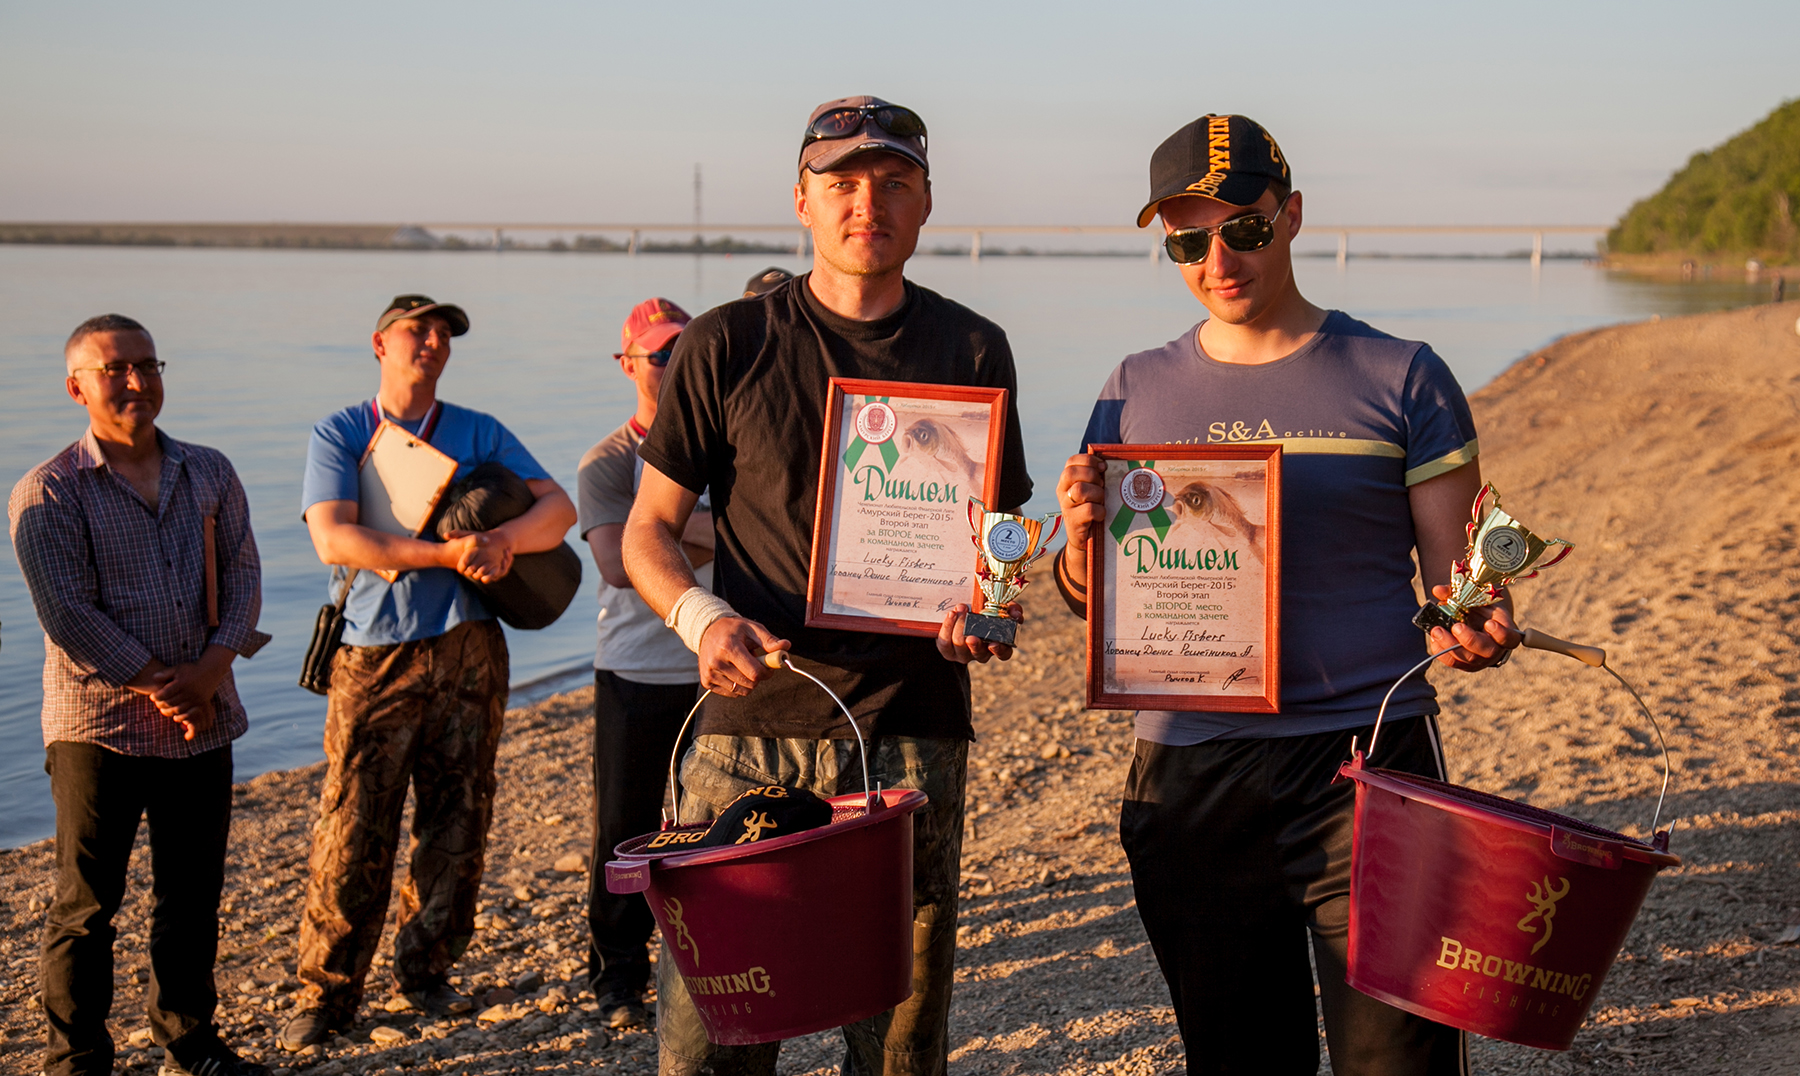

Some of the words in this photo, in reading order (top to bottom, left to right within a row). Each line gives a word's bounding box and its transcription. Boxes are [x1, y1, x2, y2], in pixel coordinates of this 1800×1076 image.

[1186, 116, 1231, 197] BROWNIN
[1207, 418, 1277, 442] S&A
[1284, 429, 1347, 438] active
[854, 464, 960, 504] Диплом
[880, 518, 910, 528] Второй
[878, 529, 912, 538] ВТОРОЕ
[915, 533, 940, 541] место
[1005, 530, 1012, 540] 2
[1502, 538, 1514, 550] 2
[867, 539, 915, 548] командном
[917, 543, 944, 551] зачете
[1124, 535, 1240, 574] Диплом
[1156, 591, 1188, 600] Второй
[1156, 602, 1192, 610] ВТОРОЕ
[1436, 936, 1592, 1001] BROWNING
[683, 966, 771, 995] OWNING
[1463, 982, 1560, 1017] FISHING
